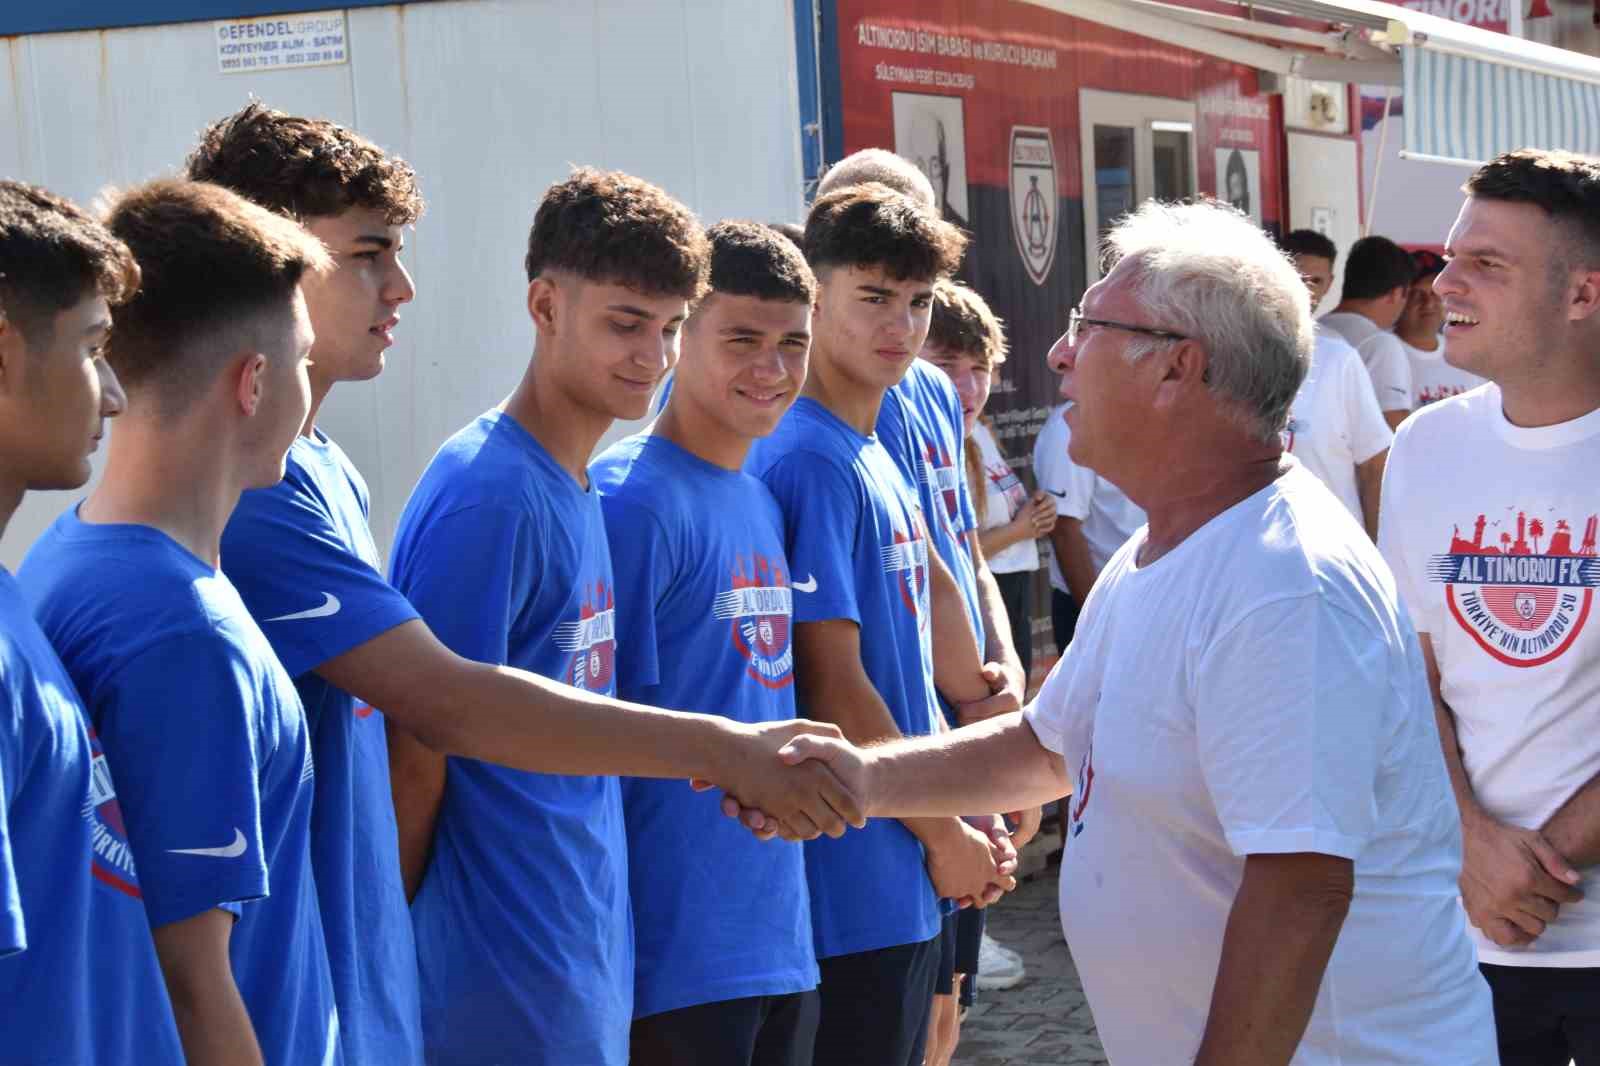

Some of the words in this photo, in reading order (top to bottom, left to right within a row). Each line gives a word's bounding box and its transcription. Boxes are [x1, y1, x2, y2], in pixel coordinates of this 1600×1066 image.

[221, 41, 279, 54] KONTEYNER
[313, 36, 343, 48] SATIM
[858, 24, 915, 51] ALTINORDU
[938, 34, 972, 58] BABASI
[984, 41, 1019, 65] KURUCU
[875, 61, 915, 83] SÜLEYMAN
[1458, 556, 1556, 583] ALTINORDU
[1558, 558, 1584, 585] FK
